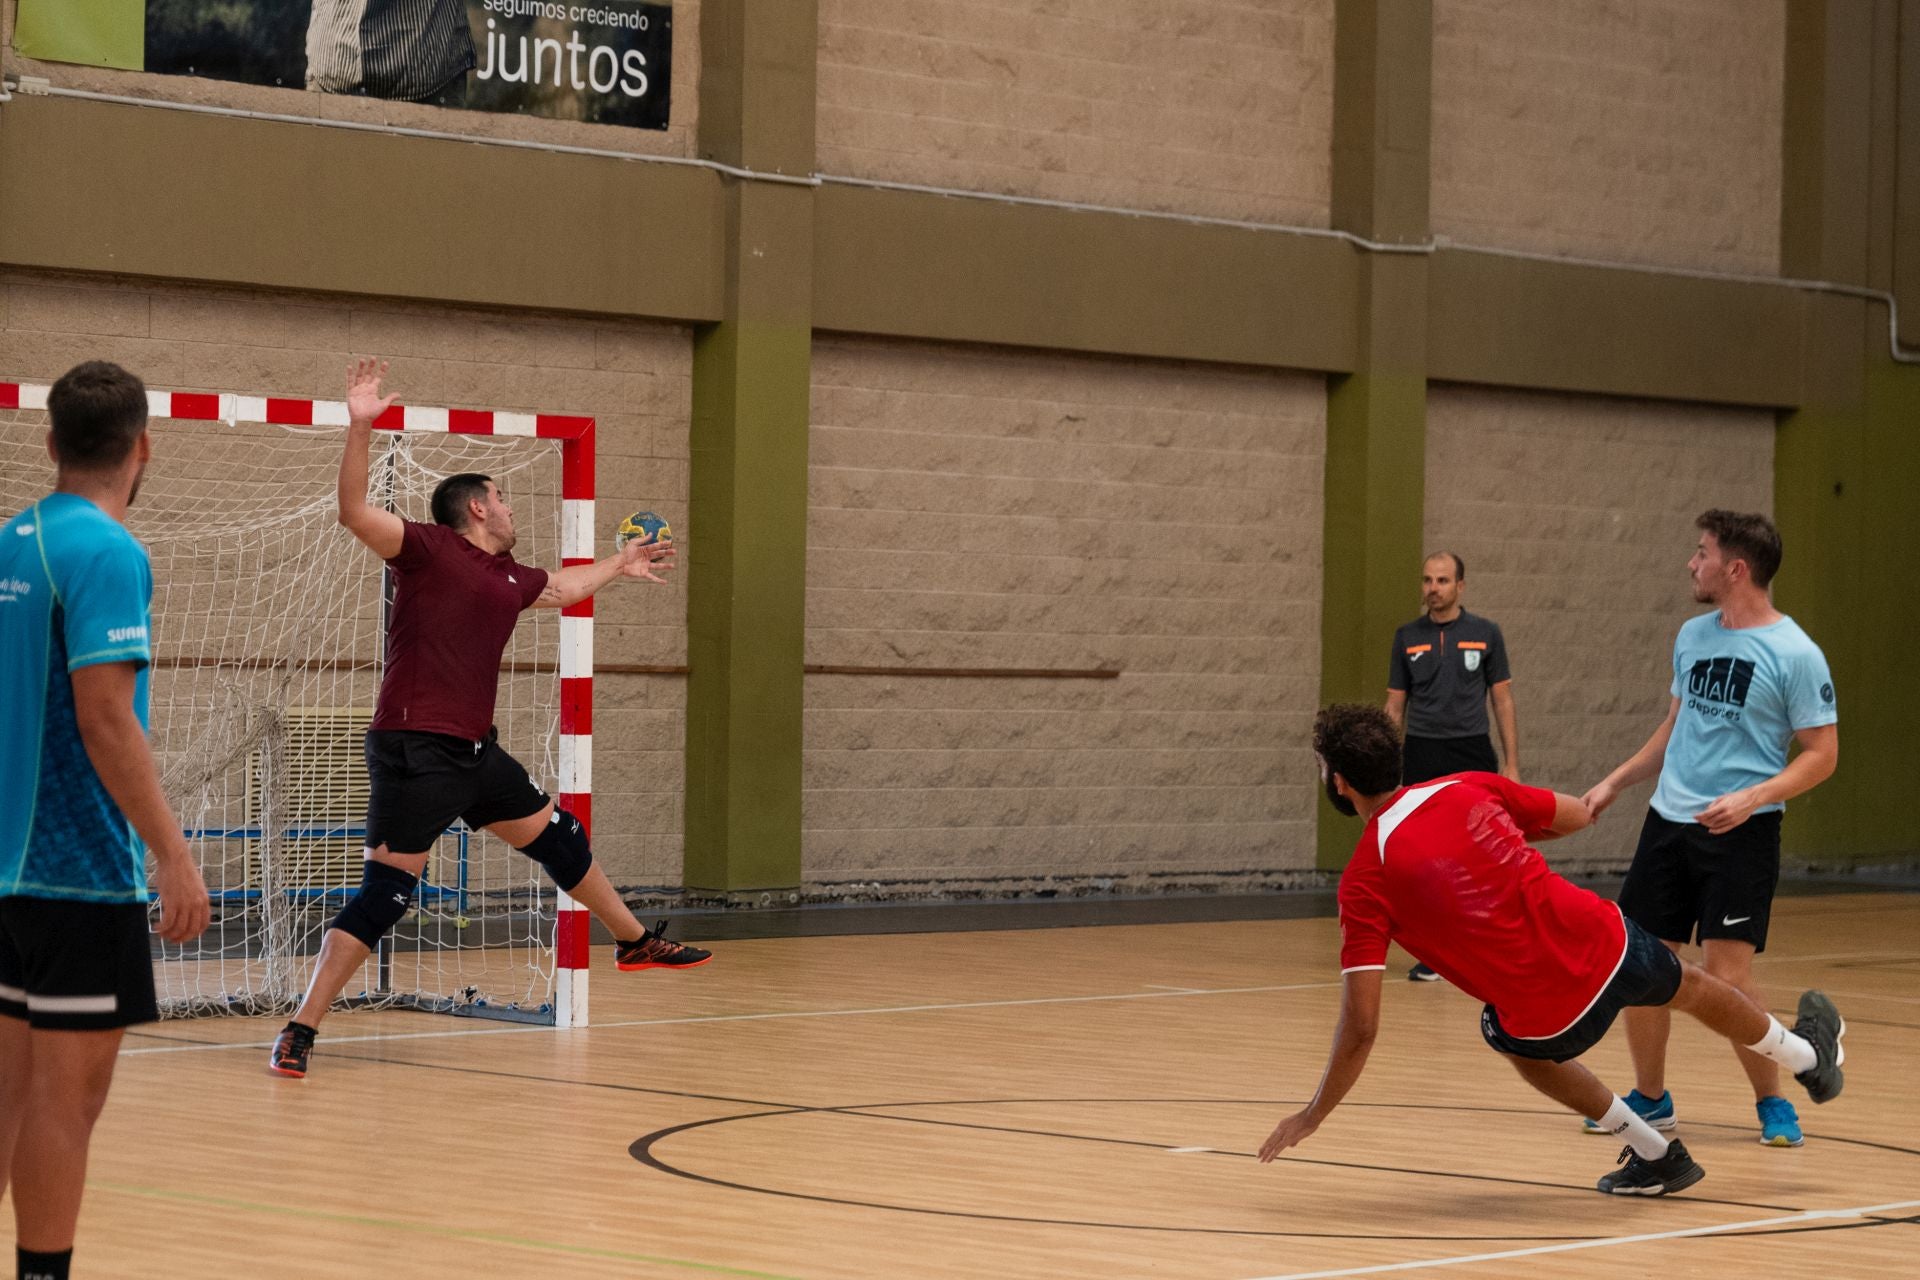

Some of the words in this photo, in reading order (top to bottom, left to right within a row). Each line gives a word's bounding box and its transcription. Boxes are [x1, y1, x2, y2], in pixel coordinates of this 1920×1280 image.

[483, 0, 566, 20] seguimos
[570, 6, 649, 31] creciendo
[477, 18, 648, 97] juntos
[1690, 673, 1742, 705] UAL
[1688, 698, 1740, 721] deportes
